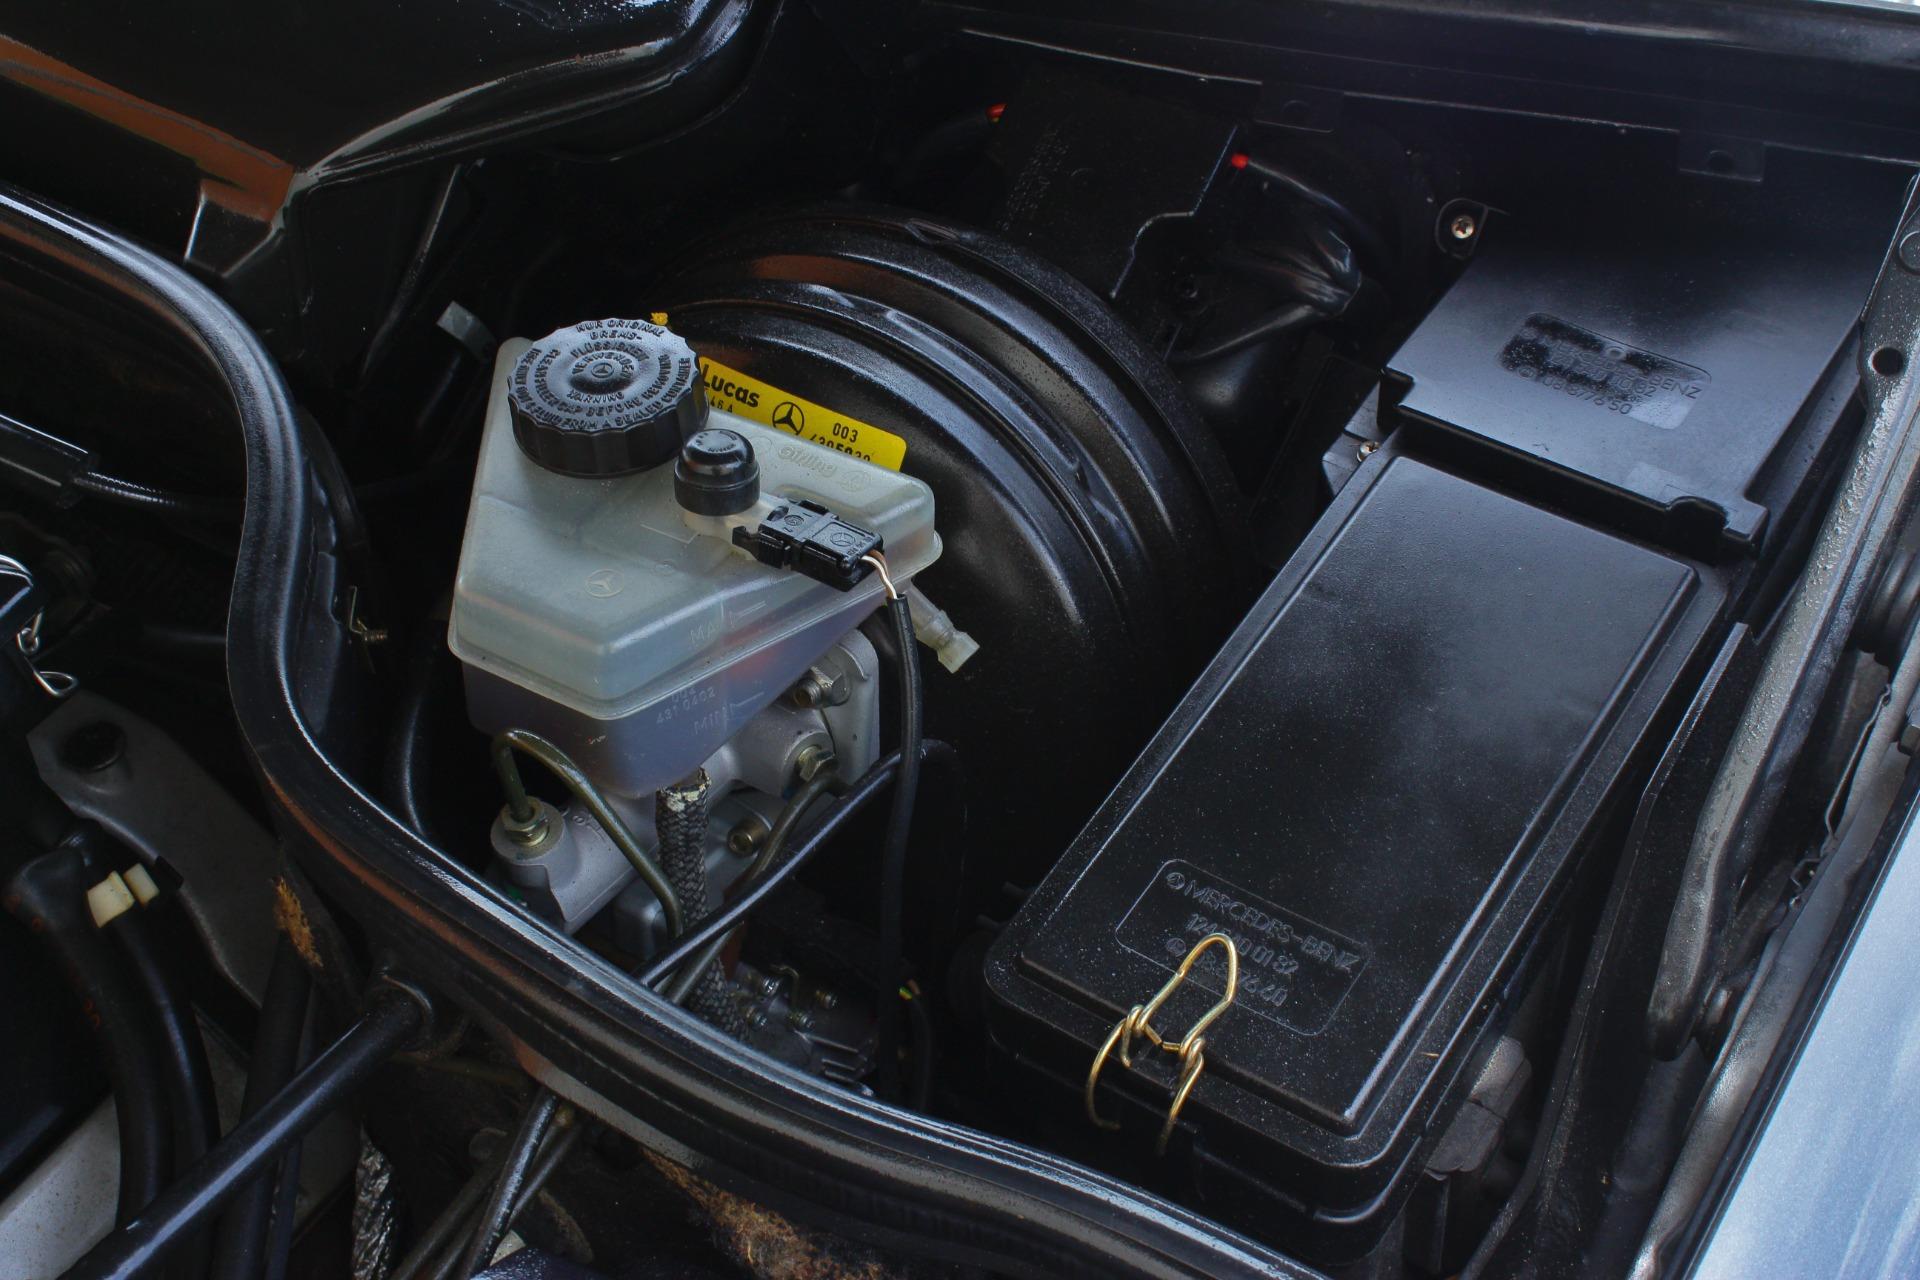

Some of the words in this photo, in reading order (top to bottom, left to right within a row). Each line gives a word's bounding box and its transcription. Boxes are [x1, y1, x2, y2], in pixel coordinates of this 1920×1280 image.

[576, 320, 603, 333] NUR
[607, 319, 665, 337] ORIGINAL
[567, 388, 625, 404] WARNING
[703, 363, 760, 408] Lucas
[586, 396, 643, 418] BEFORE
[615, 400, 664, 427] SEALED
[832, 422, 859, 443] 003
[1184, 879, 1361, 973] MERCEDES-BENZ
